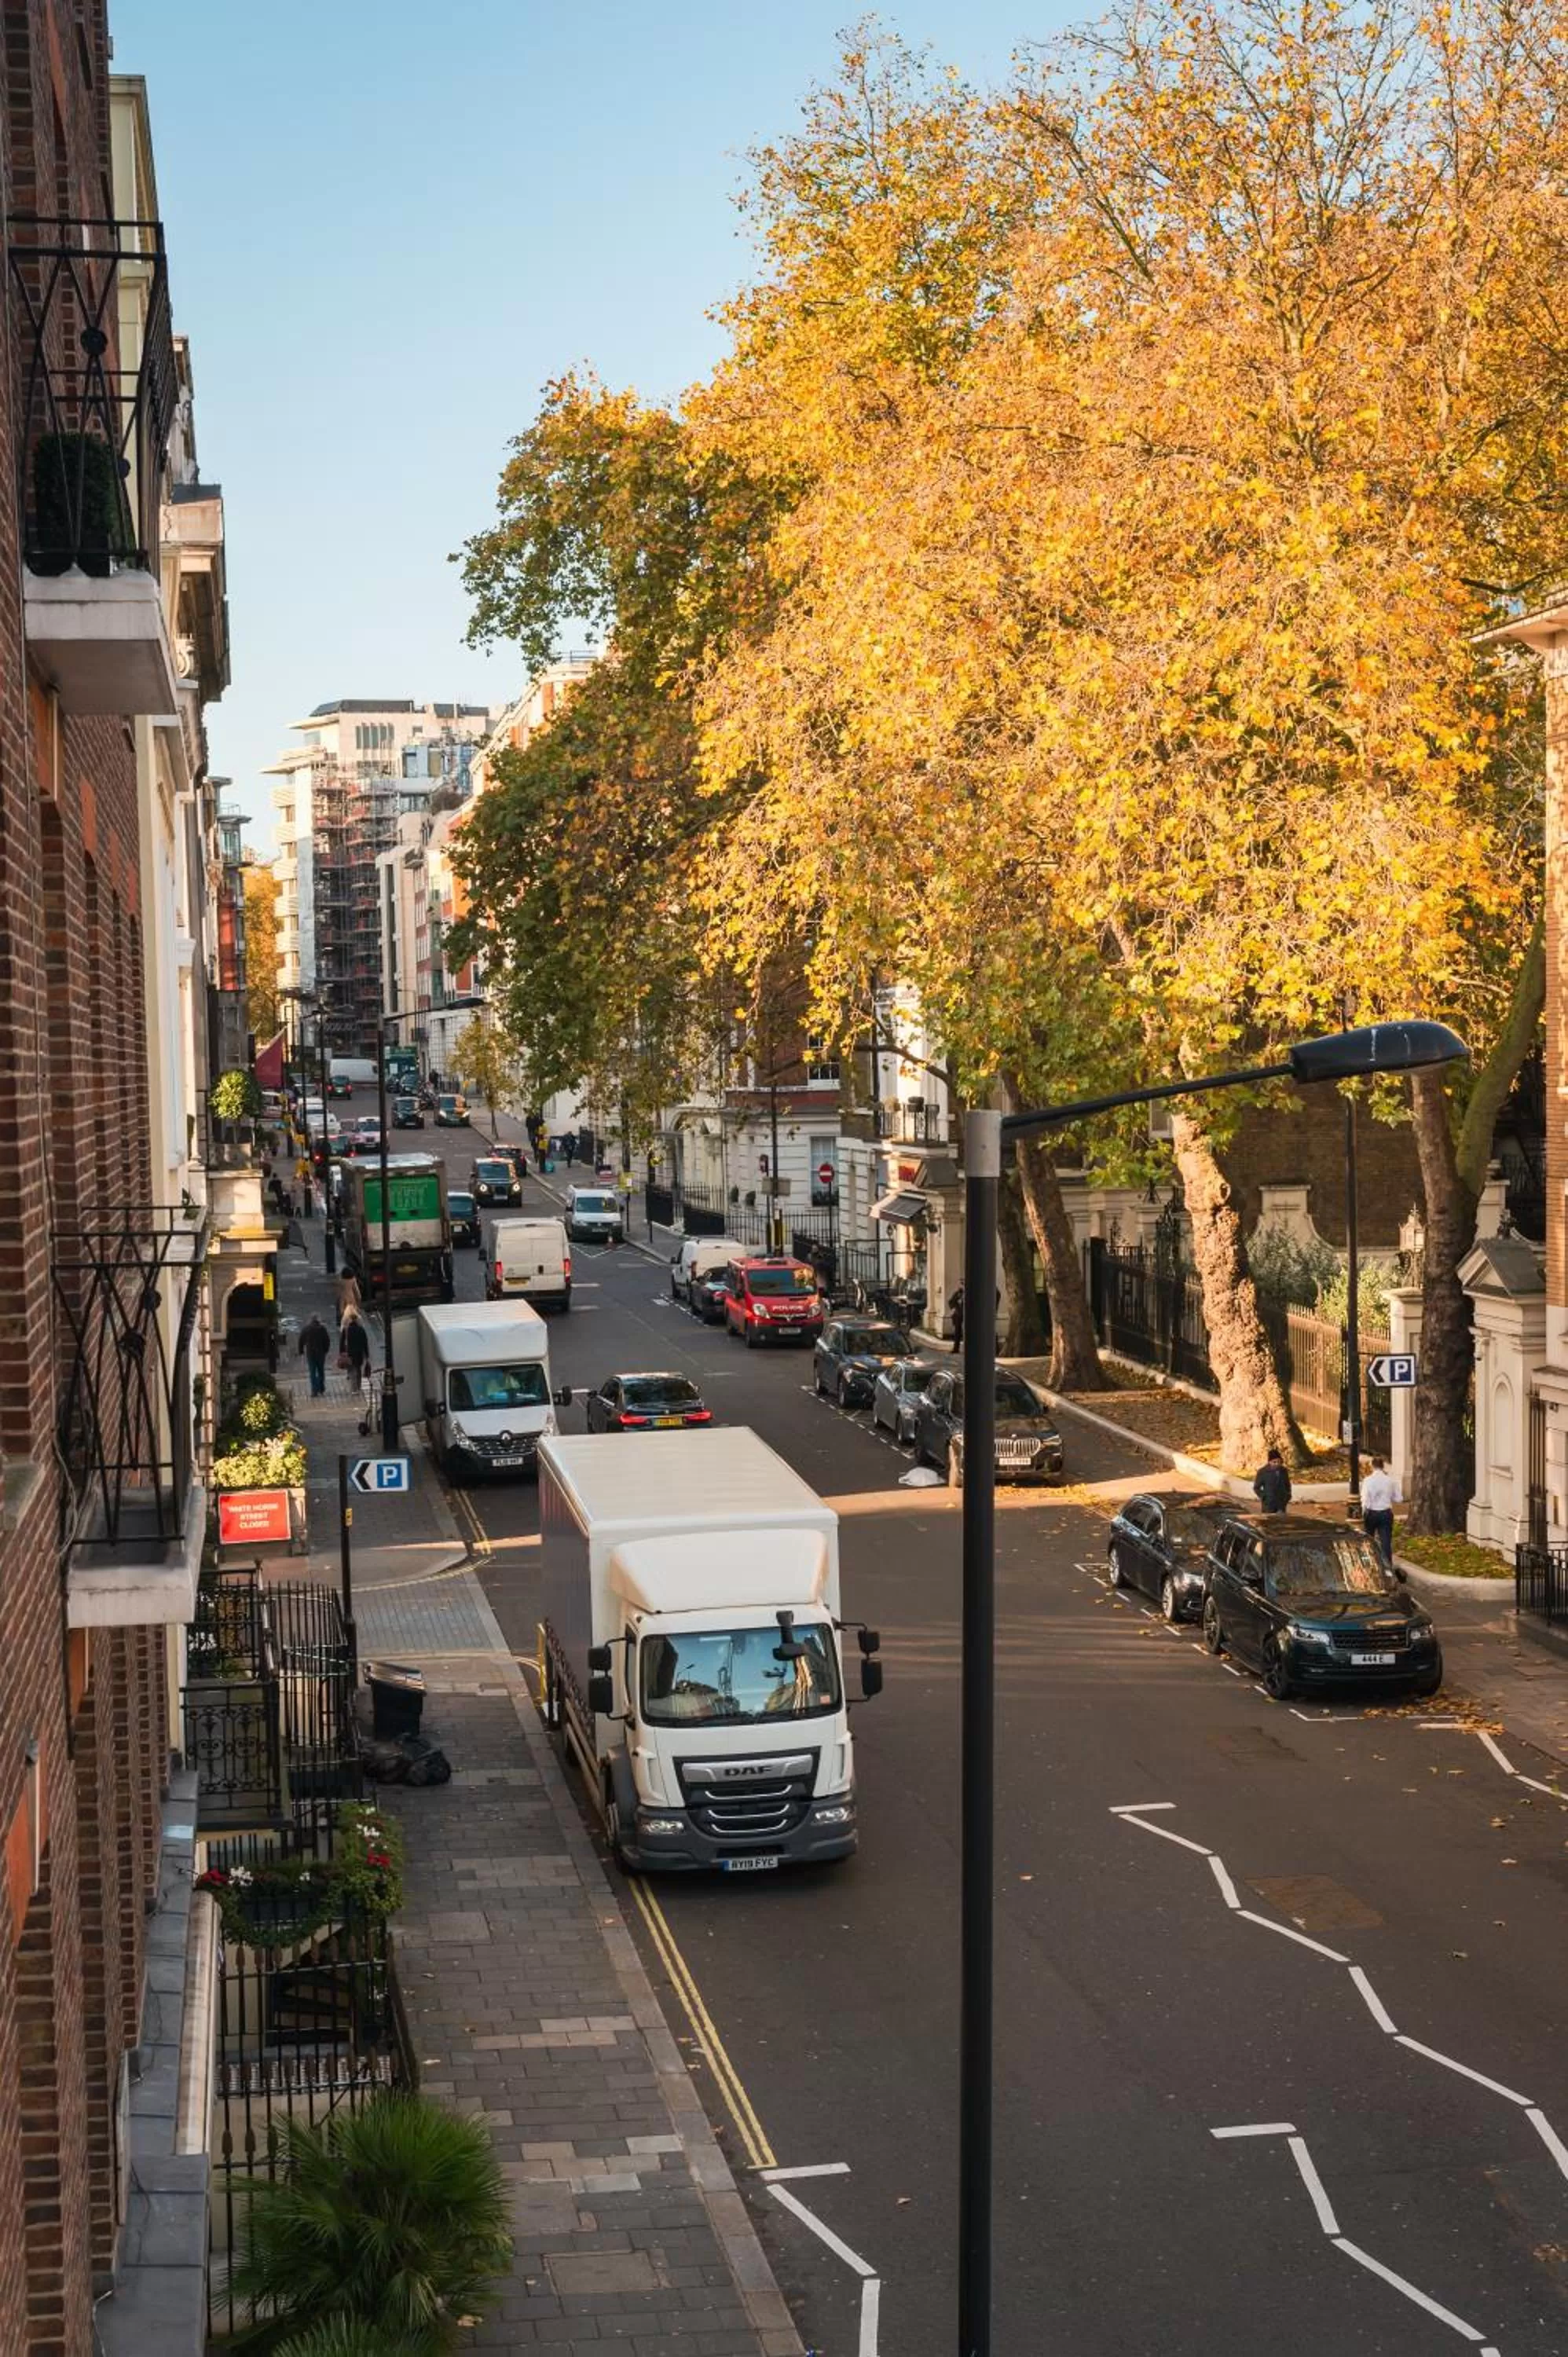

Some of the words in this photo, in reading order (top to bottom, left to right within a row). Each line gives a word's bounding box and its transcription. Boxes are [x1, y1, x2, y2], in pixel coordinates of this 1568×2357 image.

[1394, 1361, 1409, 1380] P
[383, 1466, 397, 1486] P
[724, 1765, 772, 1776] DAF
